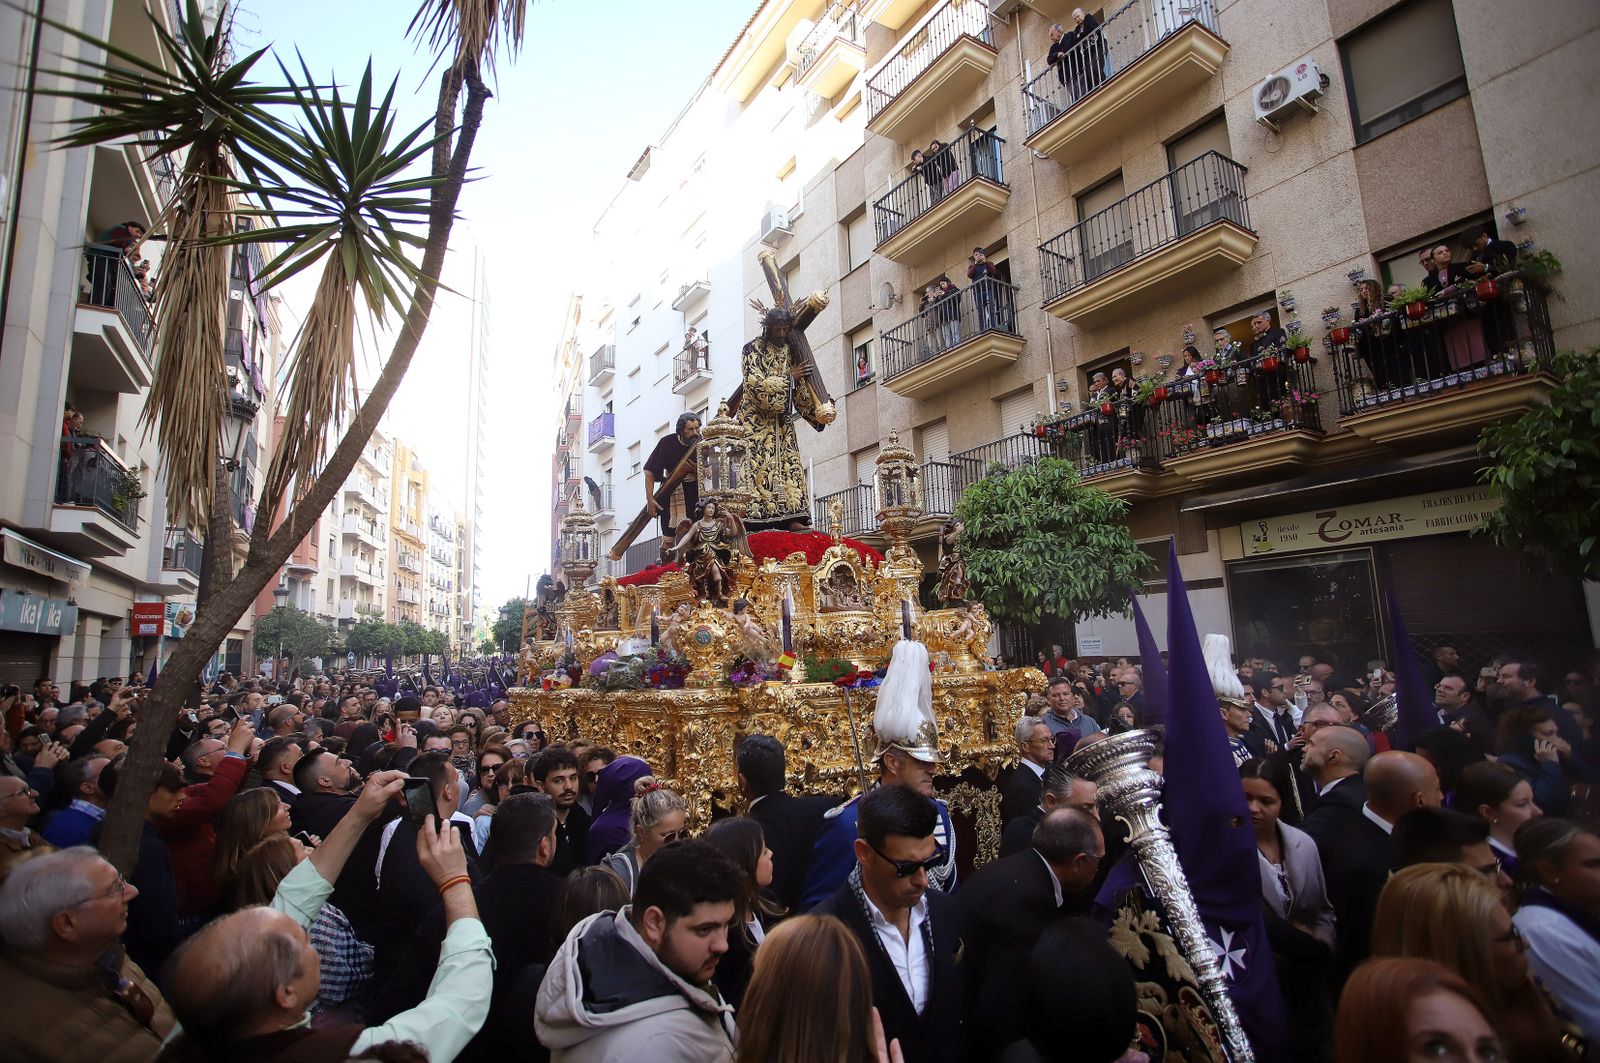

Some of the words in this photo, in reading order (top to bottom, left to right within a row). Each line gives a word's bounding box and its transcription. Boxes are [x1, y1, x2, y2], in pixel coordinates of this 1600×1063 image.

[1298, 73, 1307, 82] LG
[1421, 495, 1453, 509] TRAJES
[1454, 494, 1466, 505] DE
[1425, 511, 1479, 528] FABRICACIÓN
[1276, 523, 1300, 534] desde
